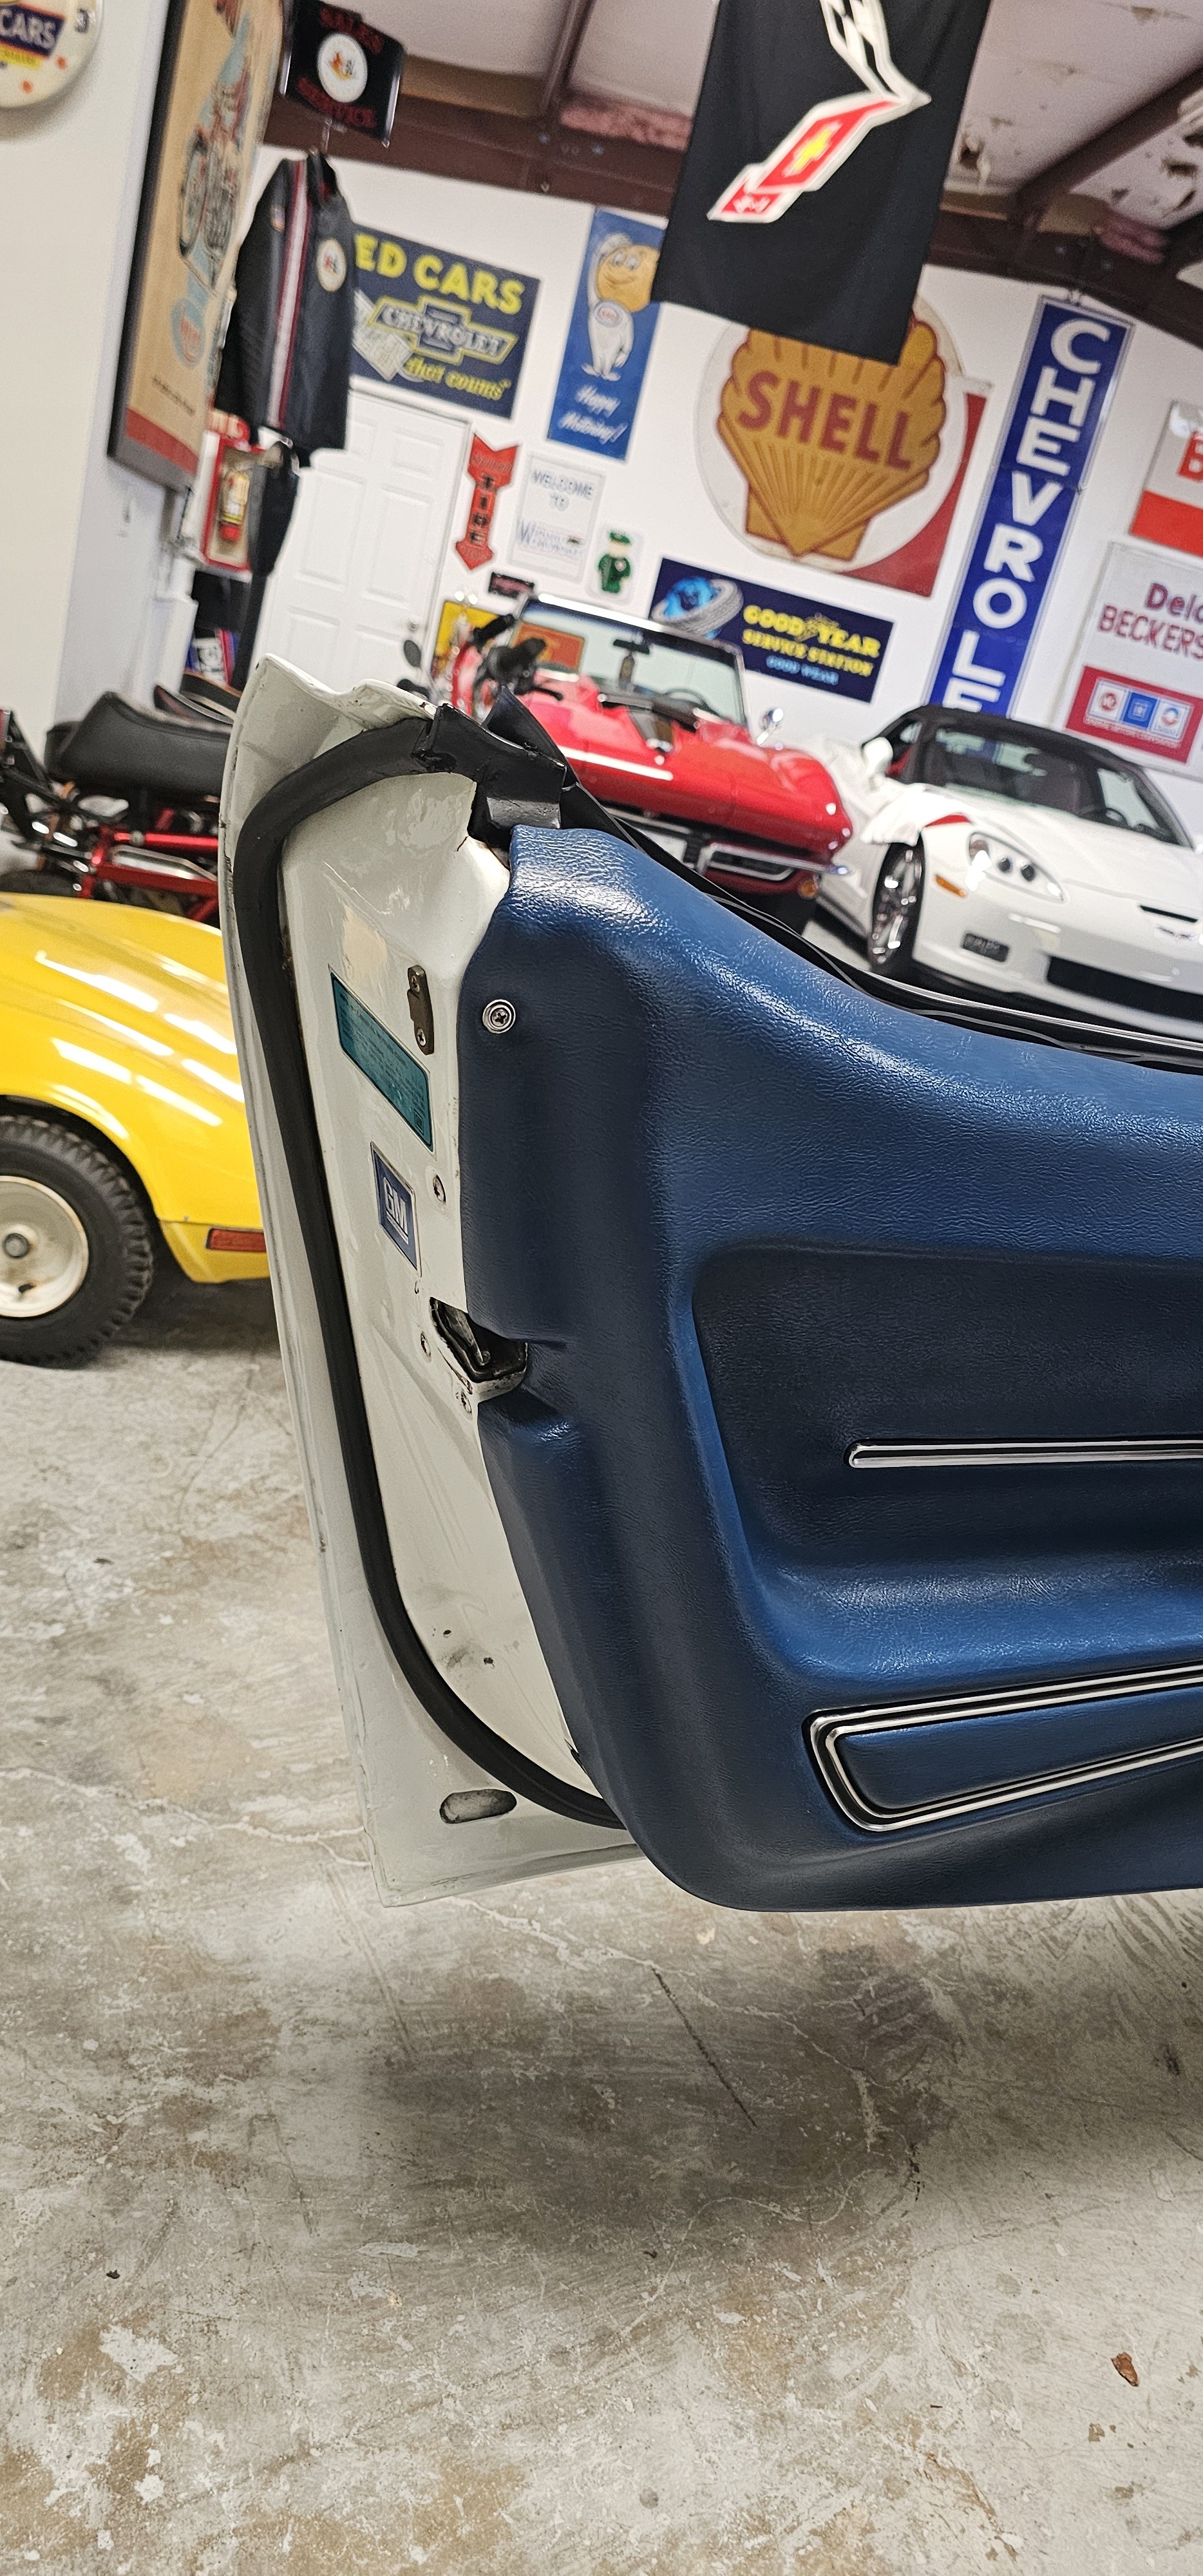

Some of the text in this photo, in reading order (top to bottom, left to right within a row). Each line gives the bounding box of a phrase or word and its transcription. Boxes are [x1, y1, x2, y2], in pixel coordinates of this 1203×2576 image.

[0, 8, 56, 49] CARS
[413, 254, 526, 316] CARS
[381, 305, 502, 357] CHEVROLET
[737, 369, 913, 471] SHELL
[532, 468, 593, 500] WELCOME
[742, 628, 873, 677] SERVICE STATION
[743, 605, 881, 658] GOOD YEAR
[383, 1177, 409, 1240] GM
